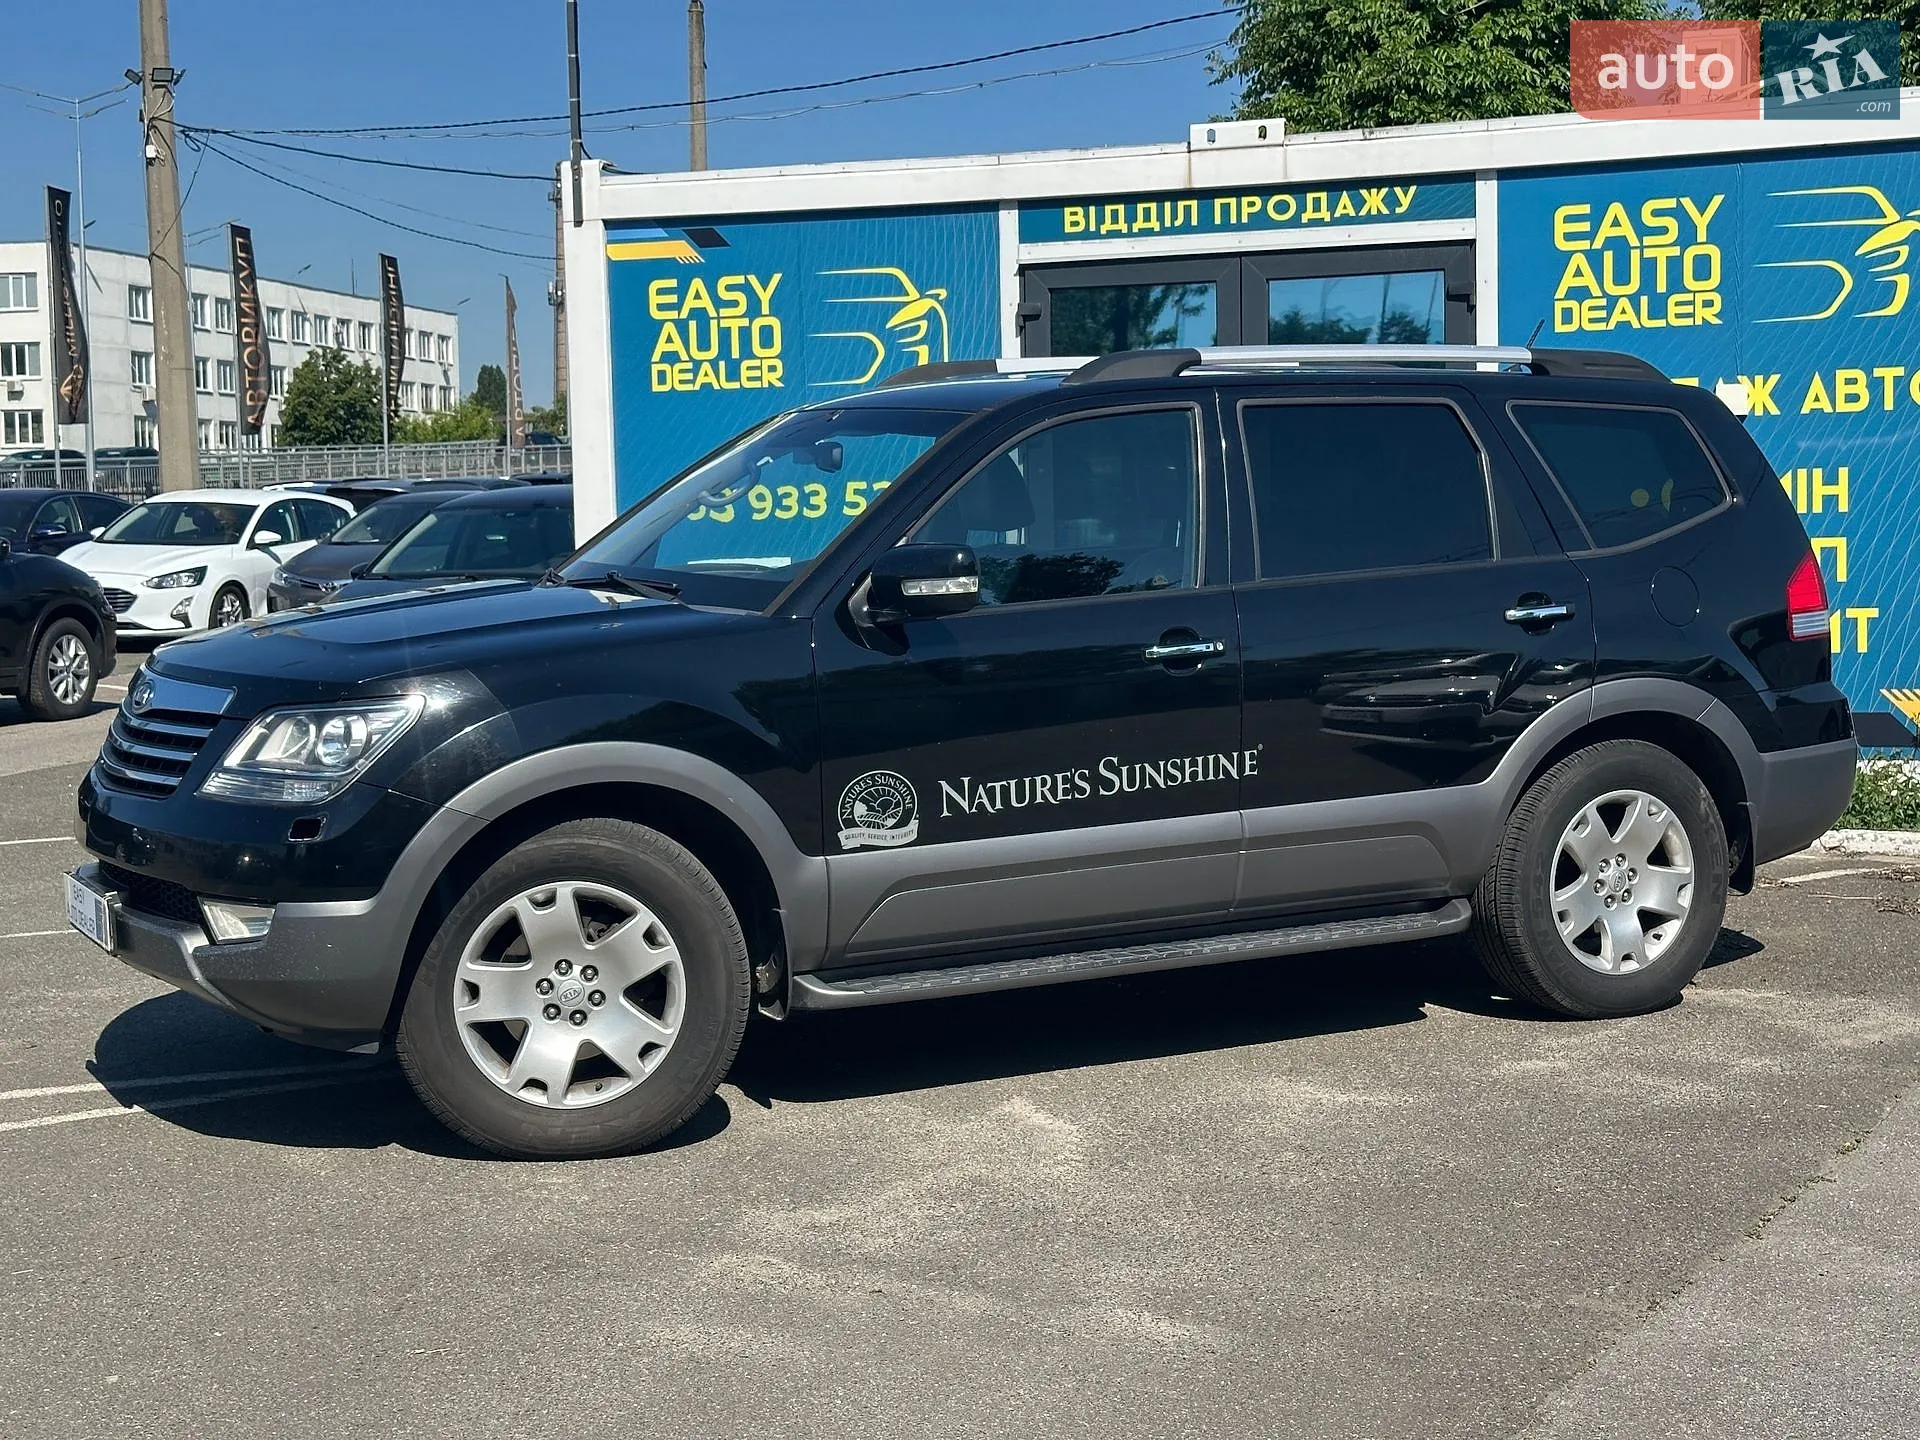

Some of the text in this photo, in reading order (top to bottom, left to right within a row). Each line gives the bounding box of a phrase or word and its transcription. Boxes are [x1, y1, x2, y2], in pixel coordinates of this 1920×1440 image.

[1064, 185, 1417, 235] ВІДДІЛ ПРОДАЖУ
[1553, 194, 1726, 252] EASY
[1554, 243, 1722, 299] AUTO
[648, 273, 783, 320] EASY
[1554, 291, 1723, 333] DEALER
[651, 316, 782, 362] AUTO
[651, 358, 785, 392] DEALER
[748, 483, 828, 520] 933
